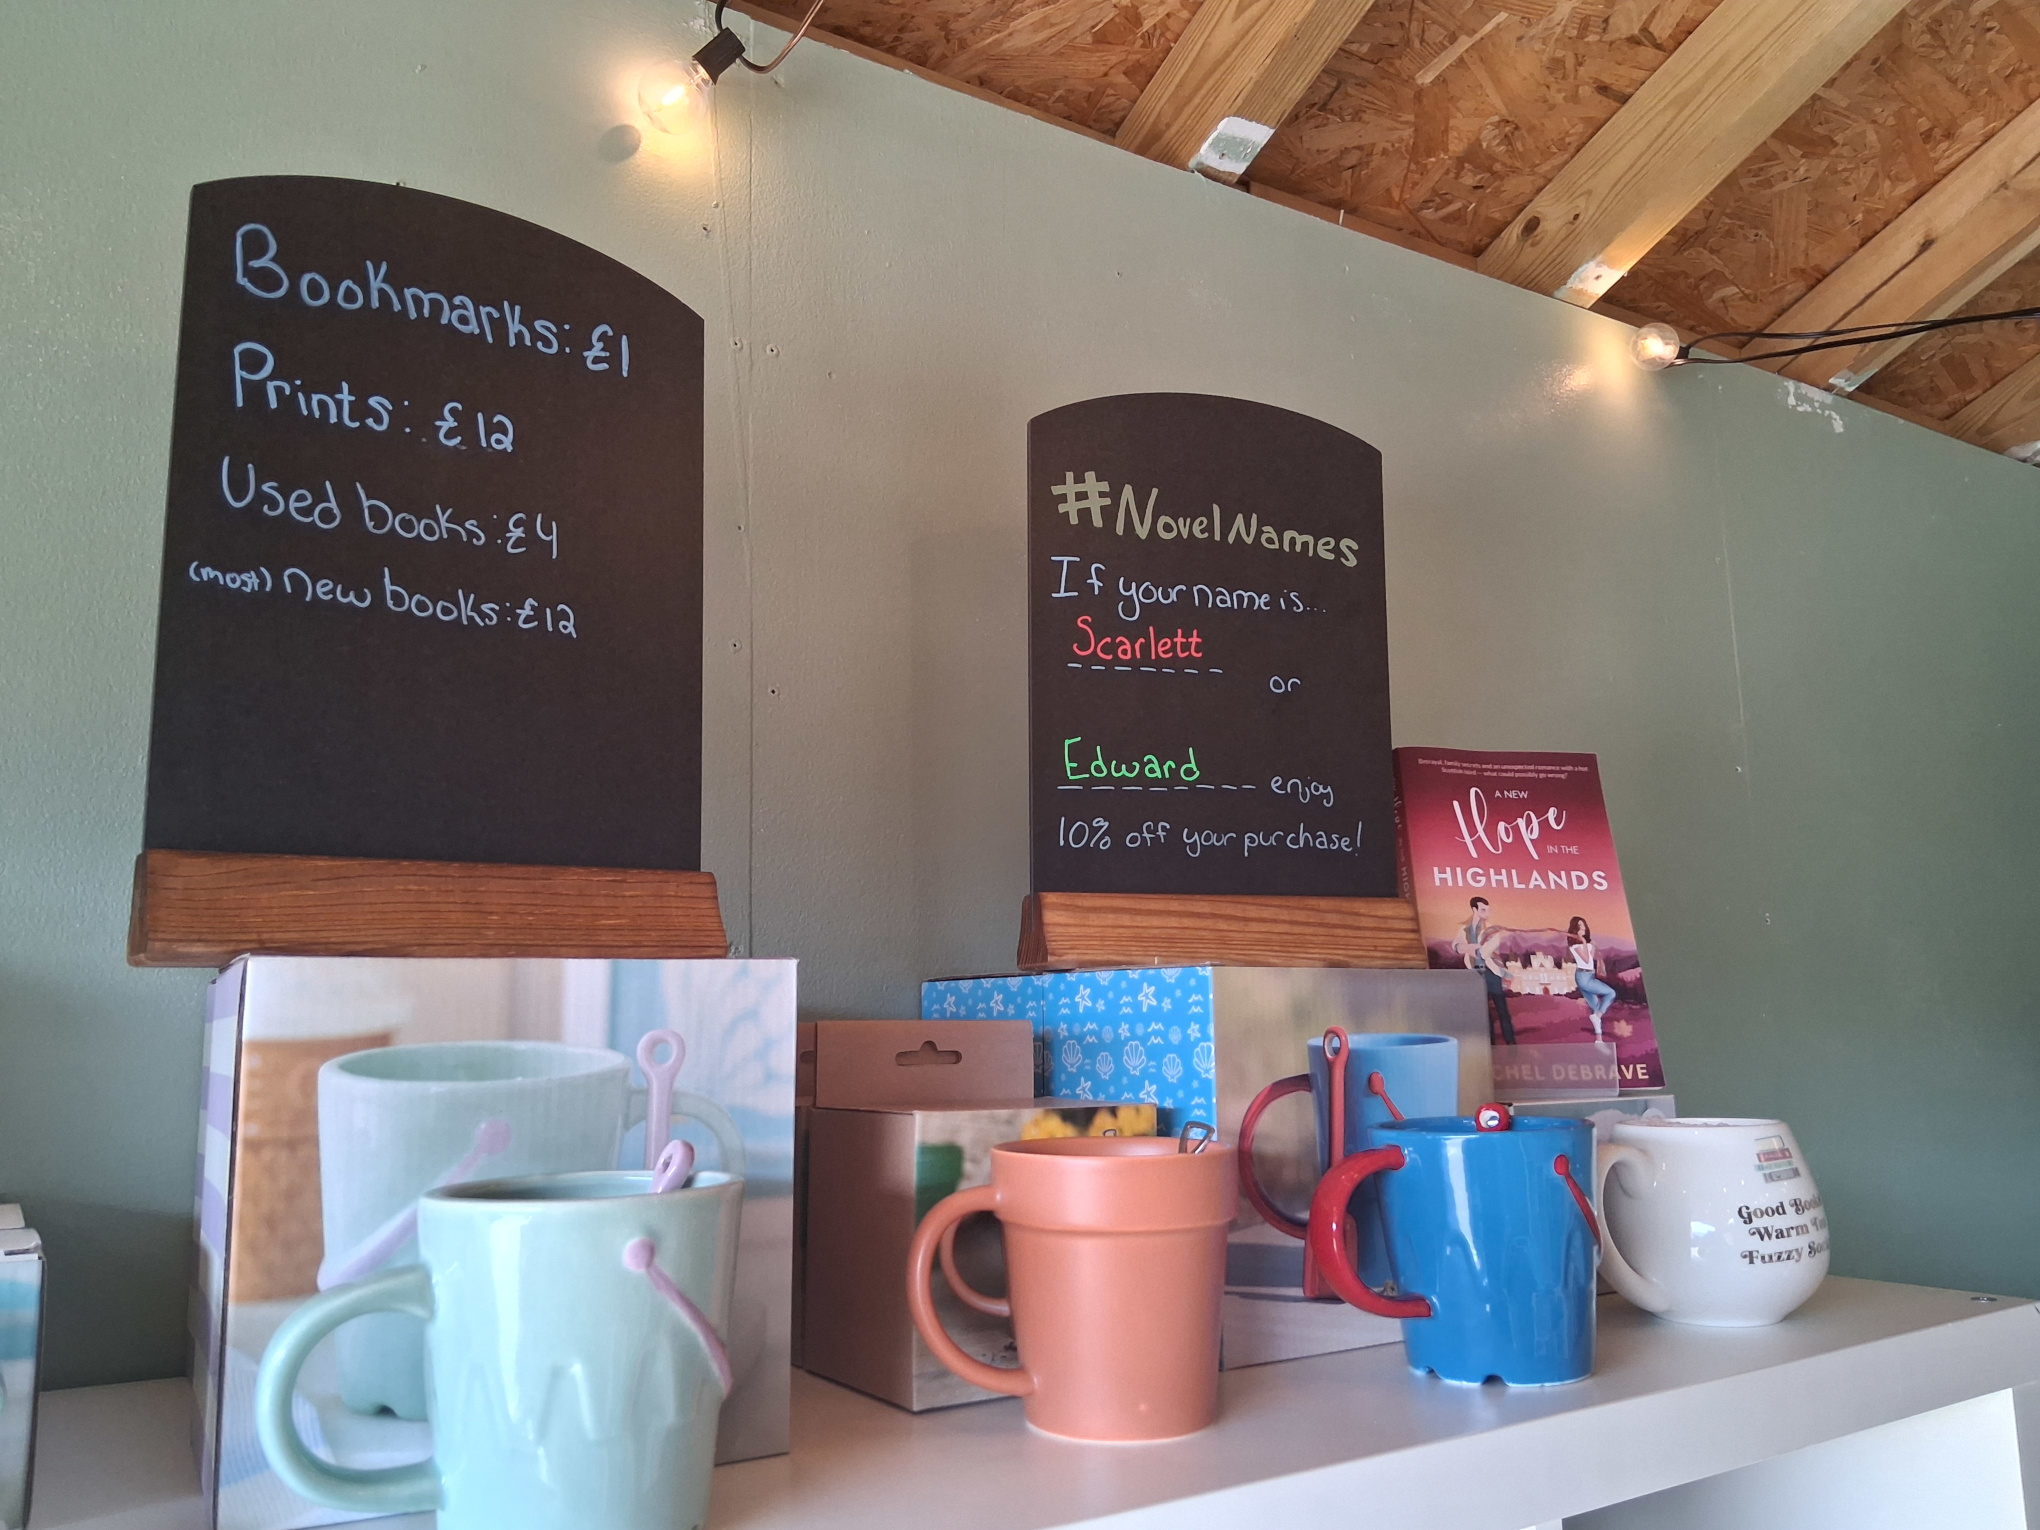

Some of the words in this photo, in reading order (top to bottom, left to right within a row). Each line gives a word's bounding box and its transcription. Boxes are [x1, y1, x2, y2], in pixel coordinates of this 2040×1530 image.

[235, 222, 572, 355] Bookmarks:
[582, 324, 629, 378] £1
[233, 341, 412, 433] Prints:
[435, 402, 515, 453] £12
[221, 455, 342, 530] Used
[355, 481, 502, 547] books:
[505, 512, 558, 560] £4
[188, 560, 273, 593] (most)
[283, 567, 372, 608] new
[383, 566, 513, 627] books:
[515, 597, 578, 639] £12
[1050, 555, 1106, 598] If
[1117, 575, 1187, 621] your
[1192, 583, 1271, 612] name
[1071, 614, 1203, 660] Scarlett
[1268, 675, 1301, 694] or
[1063, 736, 1200, 782] Edward
[1269, 775, 1335, 807] enjoy
[1494, 789, 1503, 799] A
[1504, 789, 1529, 800] NEW
[1058, 816, 1113, 851] 10%
[1125, 820, 1171, 848] off
[1182, 826, 1237, 858] your
[1244, 820, 1364, 858] purchase!
[1452, 786, 1567, 861] Hope
[1546, 845, 1559, 855] IN
[1560, 845, 1580, 855] THE
[1432, 866, 1609, 891] HIGHLANDS
[1494, 1064, 1546, 1081] CHEL
[1552, 1063, 1650, 1081] DEBRAVE
[1737, 1201, 1787, 1225] Good
[1748, 1223, 1810, 1243] Warm
[1740, 1246, 1805, 1265] Fuzzy
